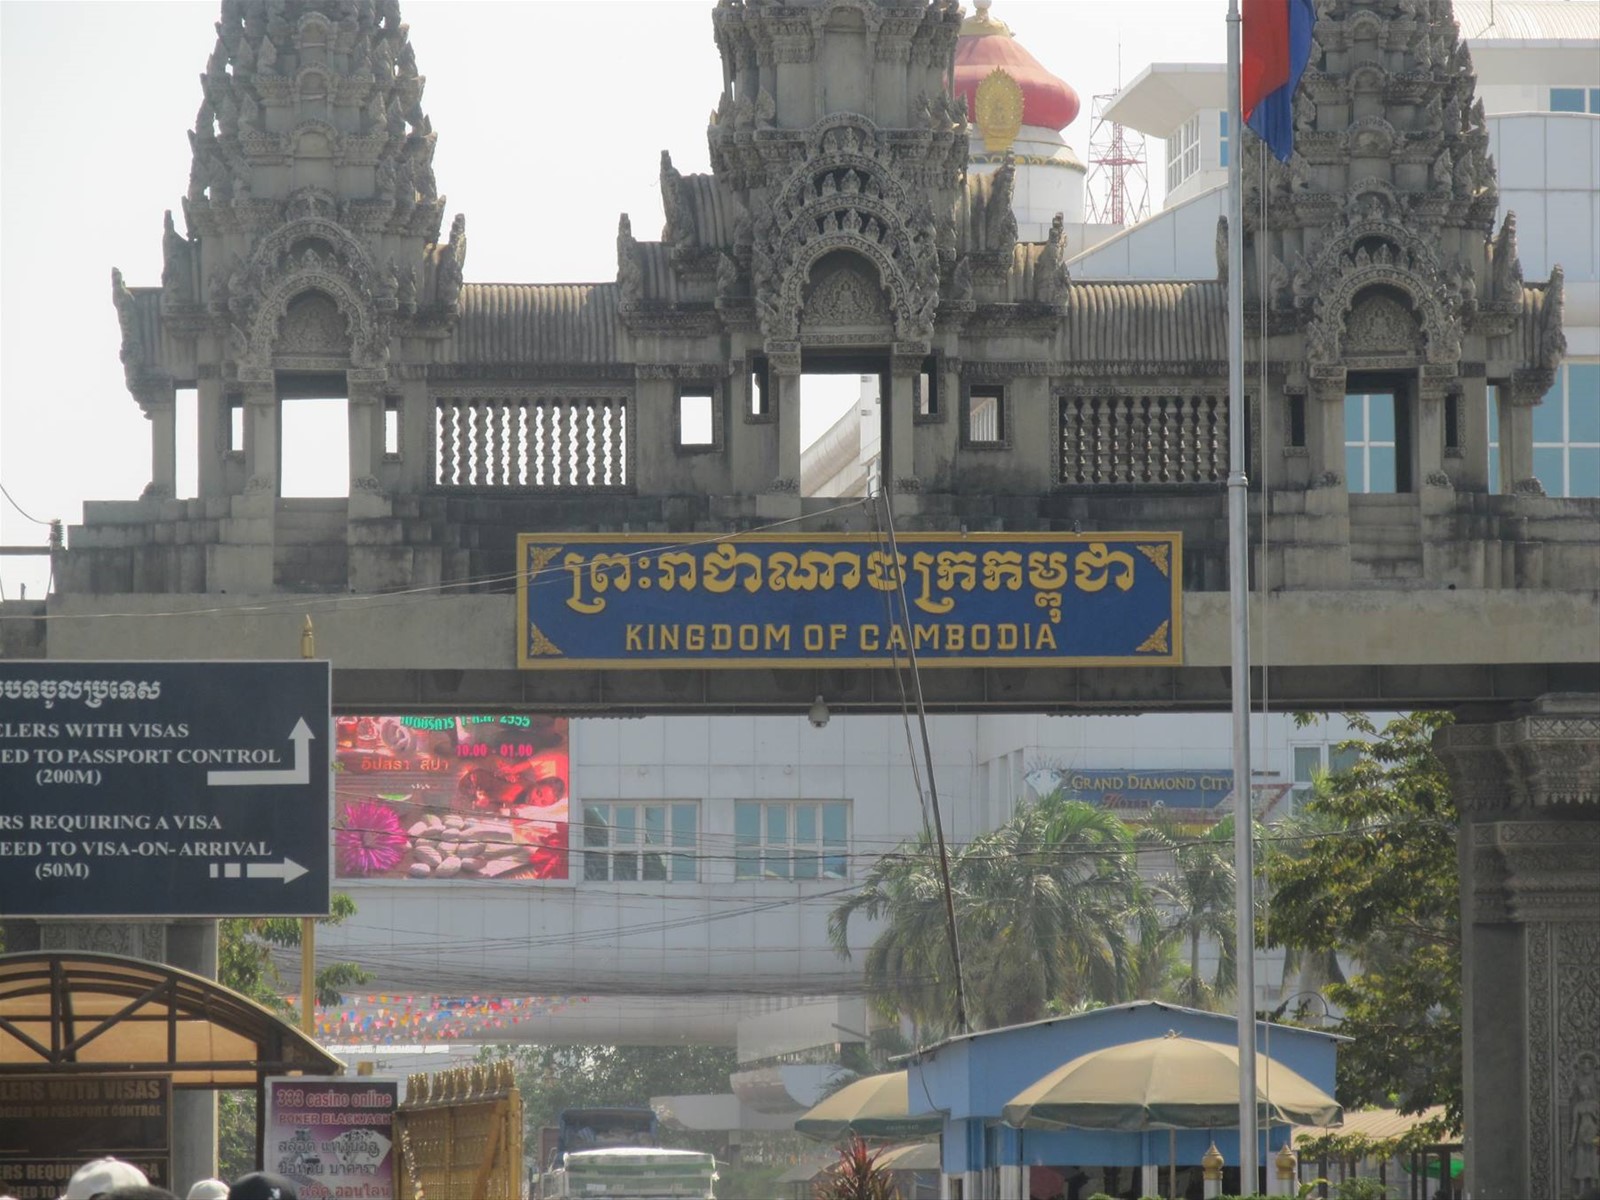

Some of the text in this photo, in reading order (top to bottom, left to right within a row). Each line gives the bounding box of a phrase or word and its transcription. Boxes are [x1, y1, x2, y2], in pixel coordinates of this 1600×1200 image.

[625, 622, 1058, 651] KINGDOM OF CAMBODIA
[65, 723, 123, 738] WITH
[128, 723, 190, 738] VISAS
[33, 749, 64, 764] TO
[67, 749, 172, 764] PASSPORT
[177, 749, 281, 764] CONTROL
[36, 769, 102, 786] (200M)
[1127, 774, 1196, 790] DIAMOND
[30, 815, 151, 833] REQUIRING
[155, 816, 169, 830] A
[173, 815, 222, 830] VISA
[47, 842, 77, 857] TO
[35, 863, 90, 880] (50M)
[50, 1080, 99, 1099] WITH
[103, 1080, 160, 1099] VISAS
[305, 1090, 349, 1107] casino
[351, 1090, 392, 1107] online
[111, 1105, 161, 1116] CONTROL
[279, 1114, 320, 1124] POKER
